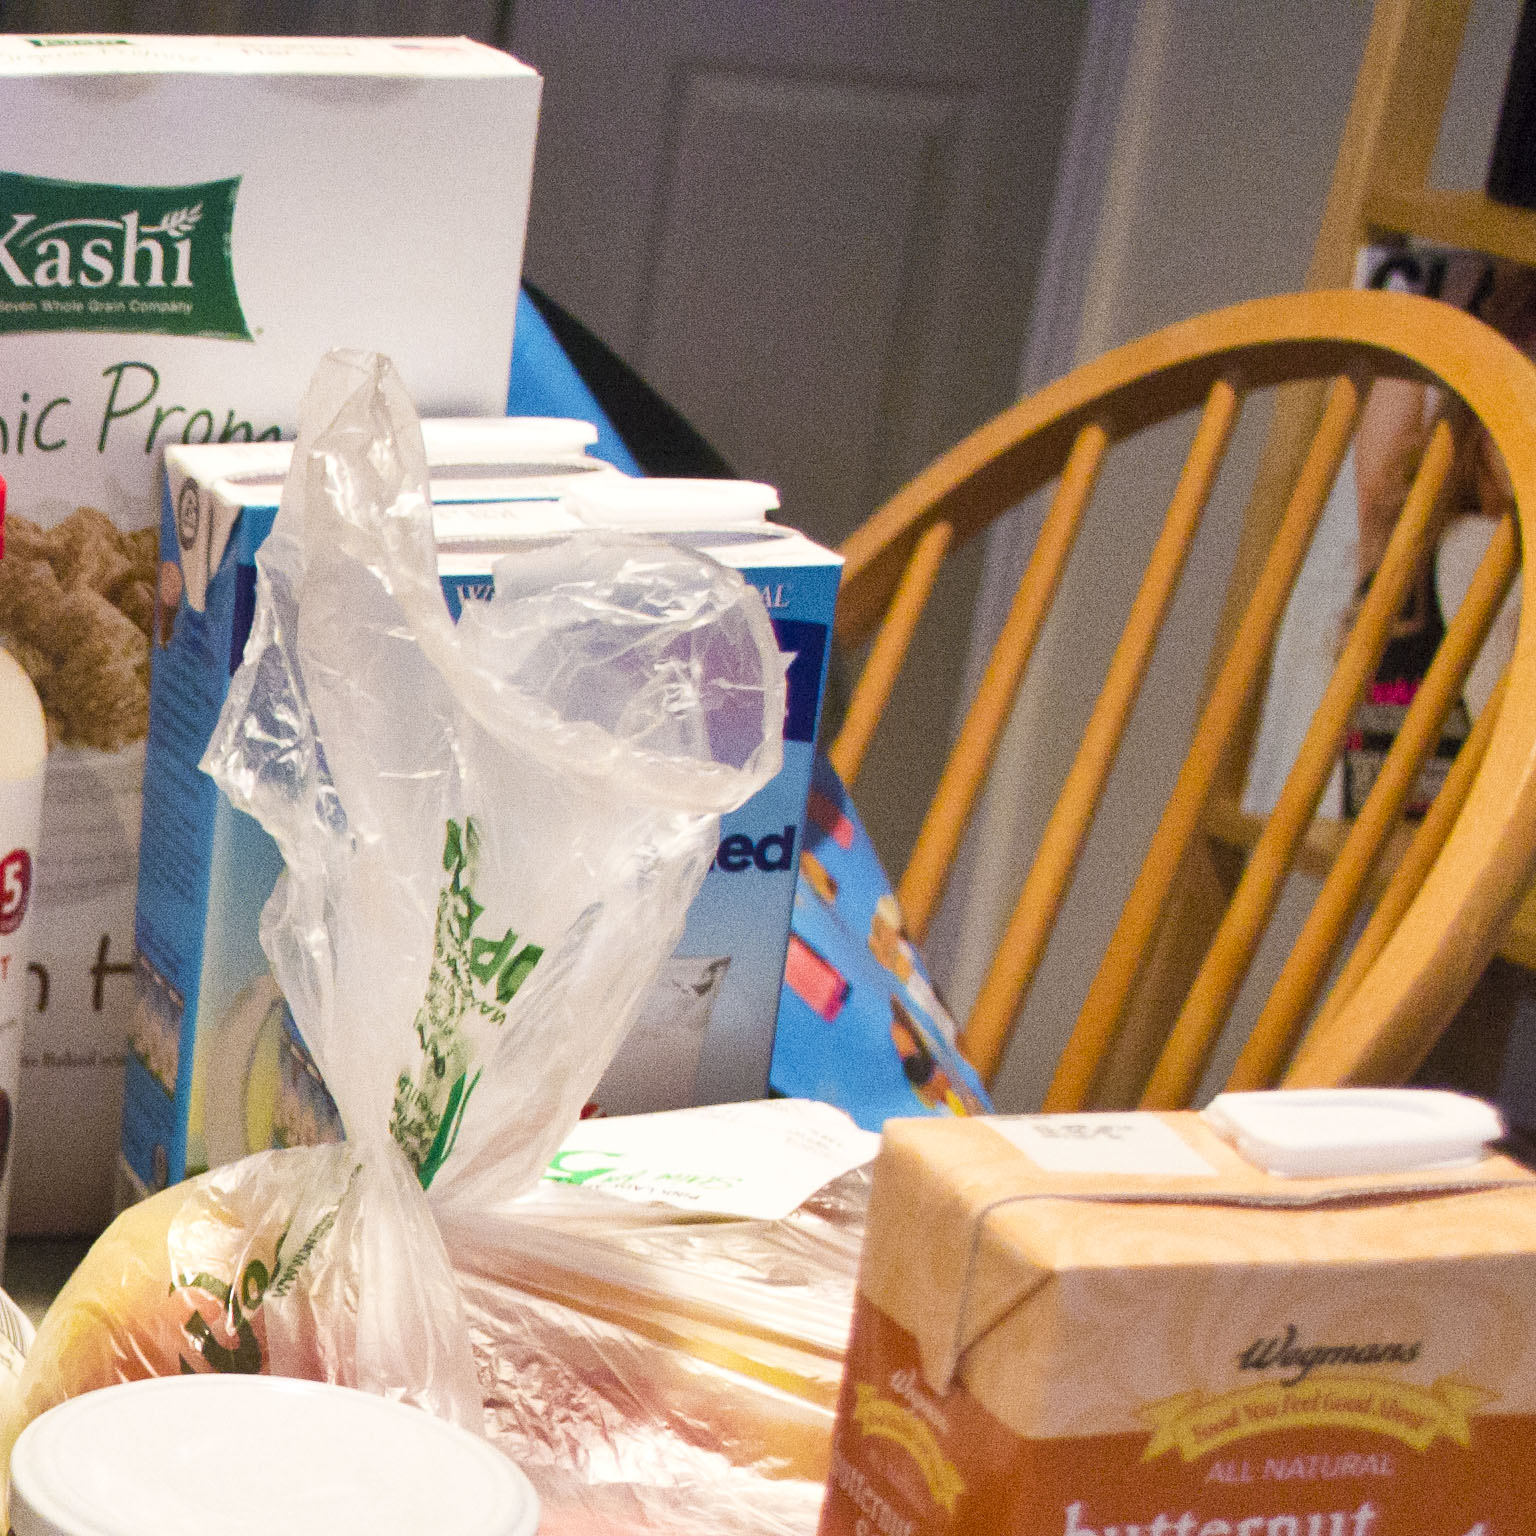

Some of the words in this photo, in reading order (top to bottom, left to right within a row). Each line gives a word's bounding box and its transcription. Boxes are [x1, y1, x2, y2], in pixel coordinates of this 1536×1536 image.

[99, 361, 282, 455] Prom
[1238, 1323, 1422, 1389] Wegmans
[1206, 1459, 1252, 1483] ALL
[1262, 1452, 1395, 1481] NATURAL
